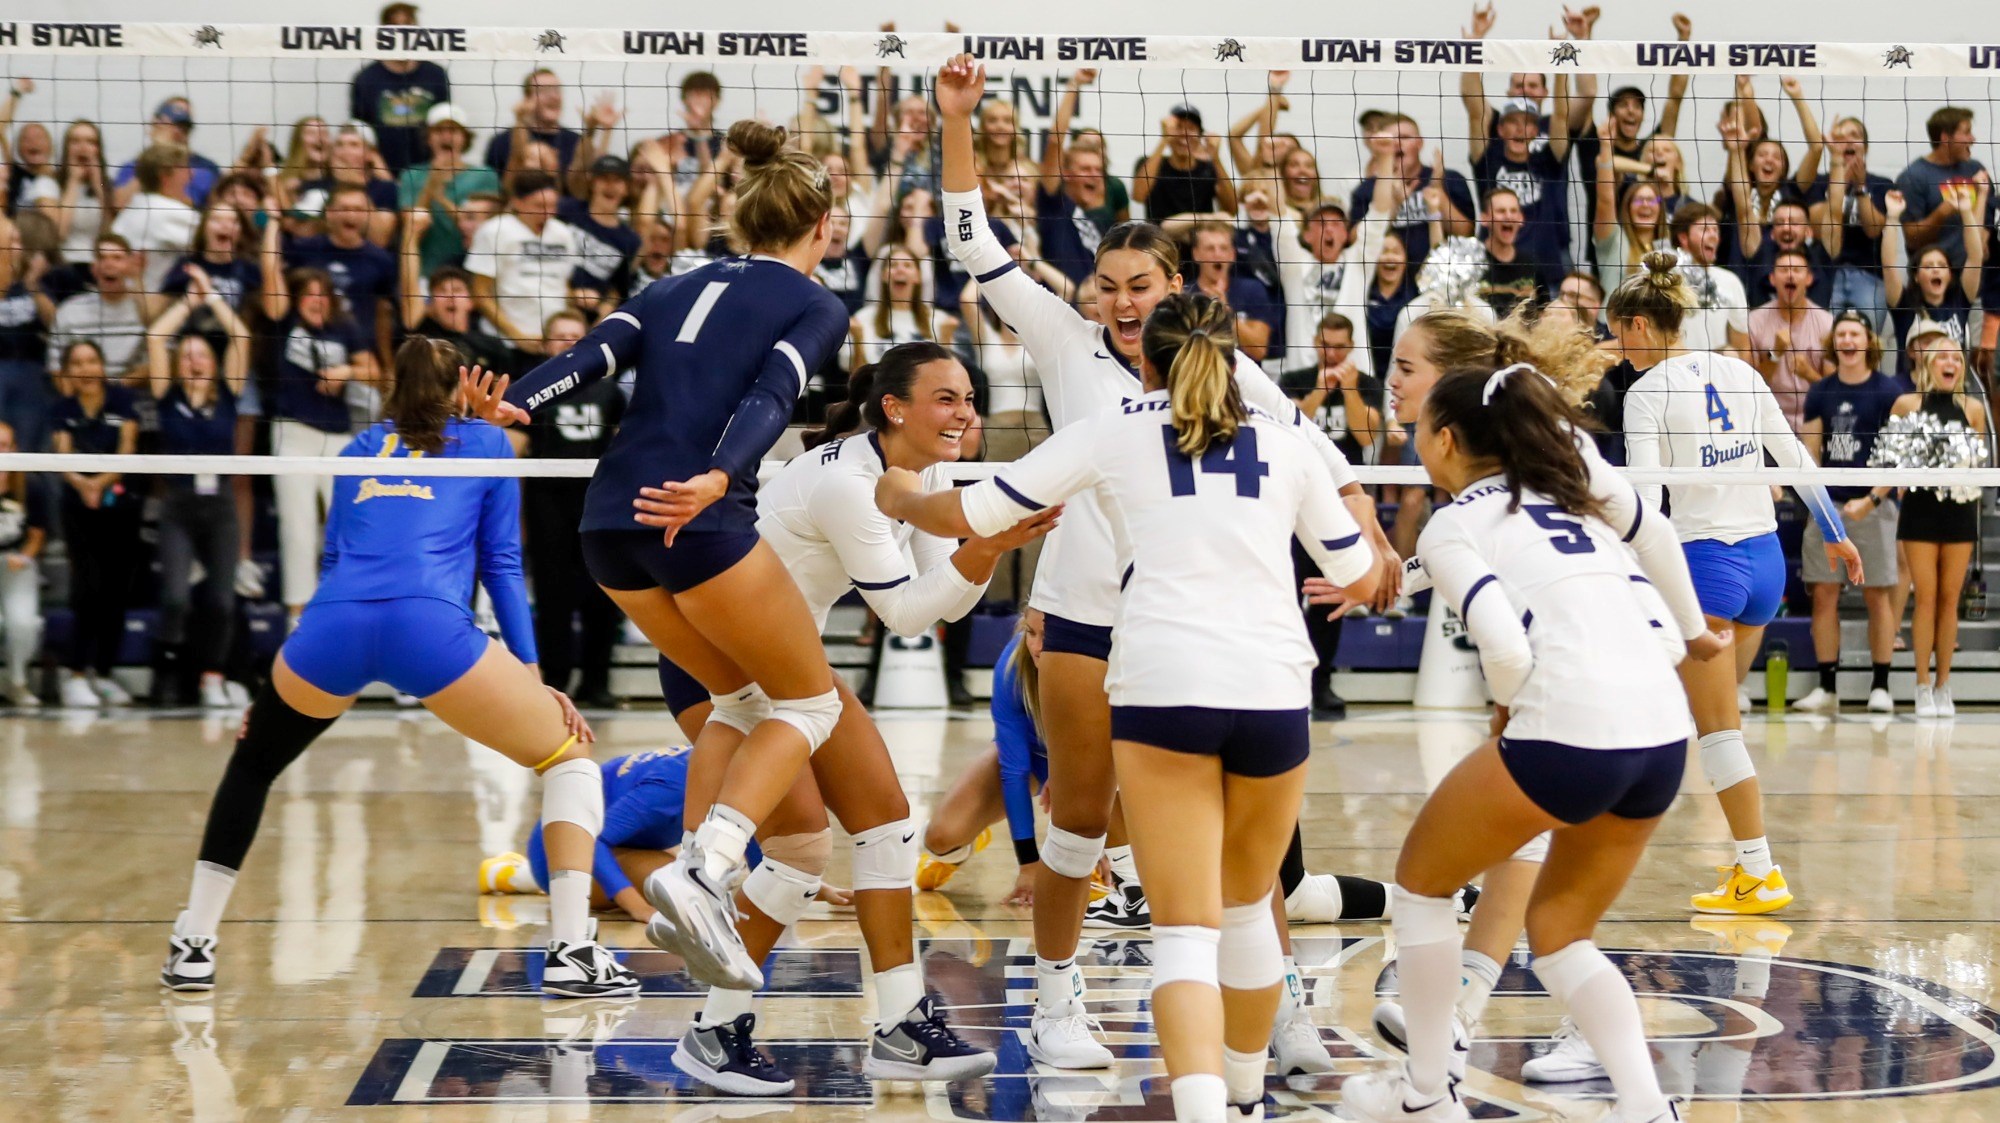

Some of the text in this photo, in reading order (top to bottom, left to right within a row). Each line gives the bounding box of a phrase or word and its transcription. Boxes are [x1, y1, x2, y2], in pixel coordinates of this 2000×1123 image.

[32, 23, 122, 47] STATE
[281, 26, 466, 51] UTAH STATE
[624, 31, 808, 56] UTAH STATE
[963, 35, 1043, 60] UTAH
[1058, 37, 1147, 60] STATE
[1302, 39, 1483, 65] UTAH STATE
[1637, 43, 1816, 67] UTAH STATE
[674, 281, 730, 344] 1
[526, 375, 574, 411] BELIEVE
[1704, 382, 1734, 431] 4
[1161, 424, 1269, 499] 14
[1699, 440, 1757, 467] Bruins
[1521, 504, 1596, 555] 5
